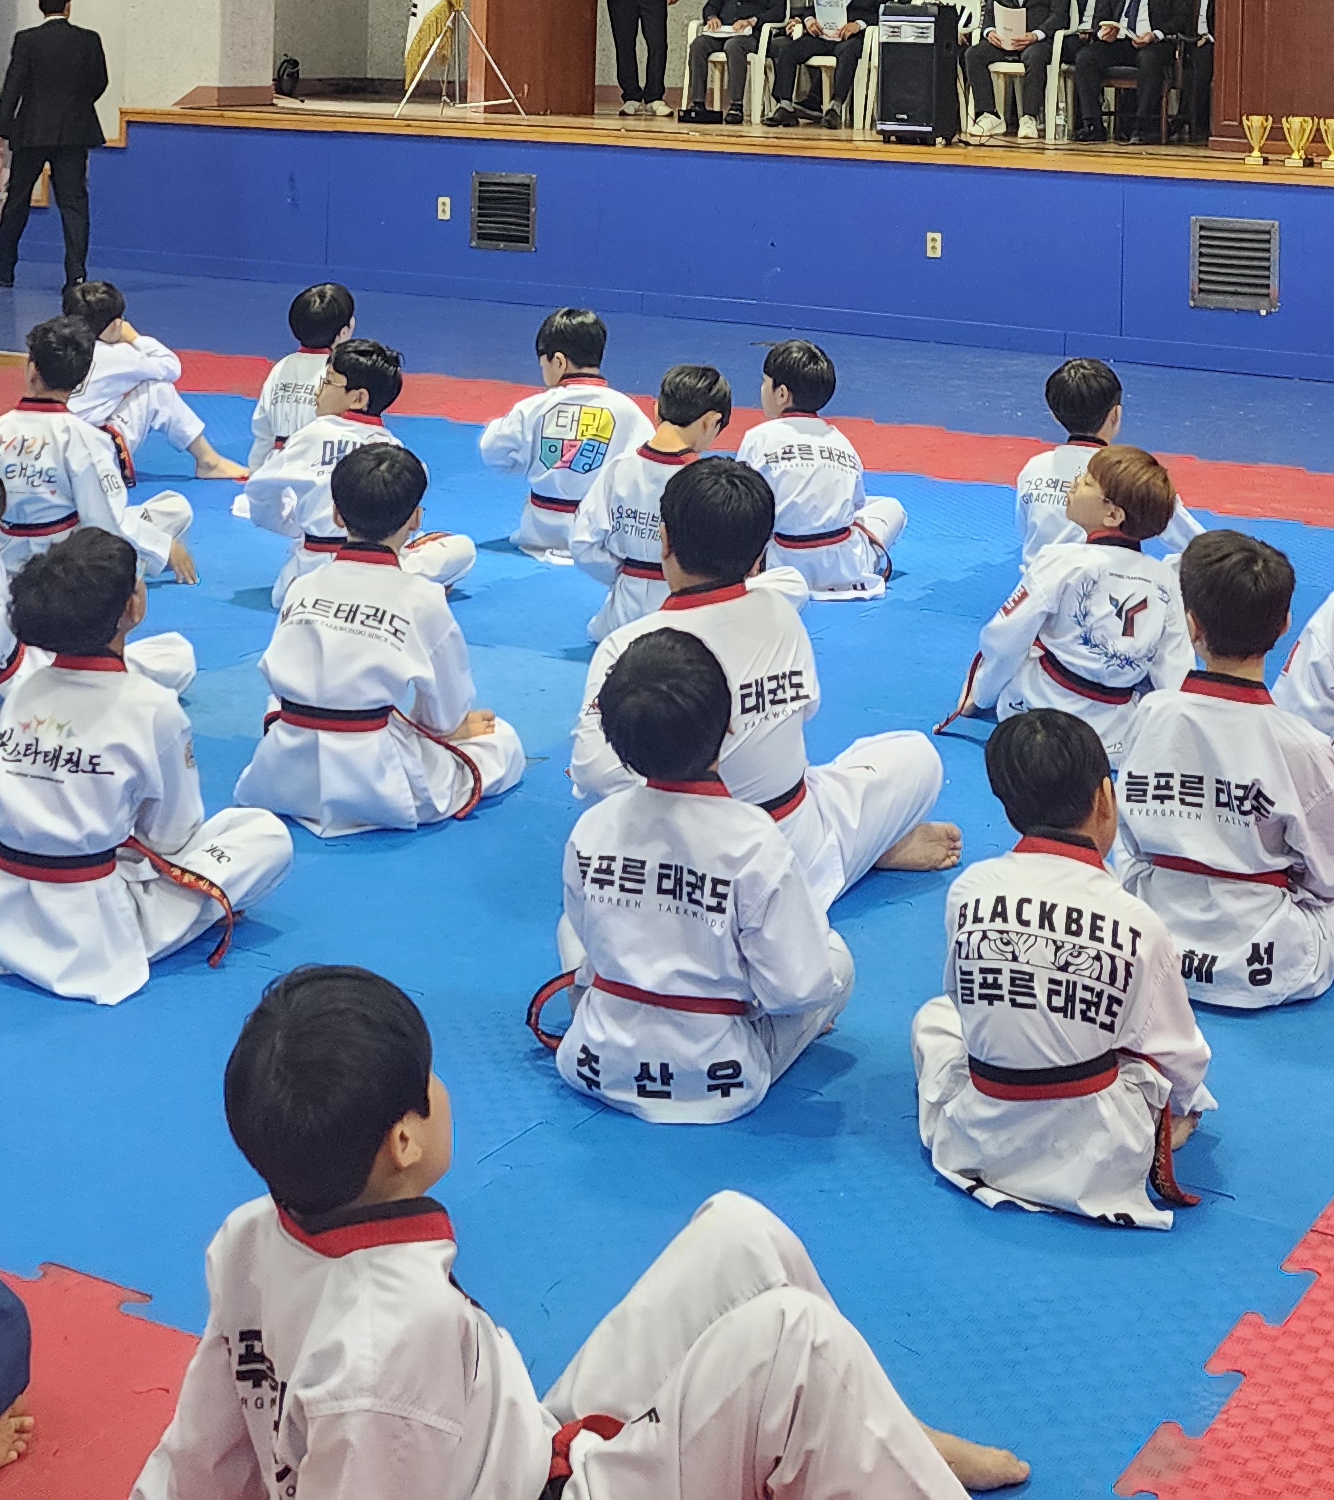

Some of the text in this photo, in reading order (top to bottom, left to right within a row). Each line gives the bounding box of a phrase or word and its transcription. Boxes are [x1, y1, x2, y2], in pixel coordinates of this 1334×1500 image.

[763, 443, 860, 473] 늘푸른 태권도
[739, 669, 812, 716] 태권도
[1125, 770, 1276, 820] 늘푸른 태권도
[1129, 808, 1203, 821] EVERGREEN
[656, 862, 732, 915] 태권도
[957, 894, 1142, 958] BLACKBELT
[1245, 941, 1275, 987] 성
[958, 965, 1124, 1035] 늘푸른 태권도
